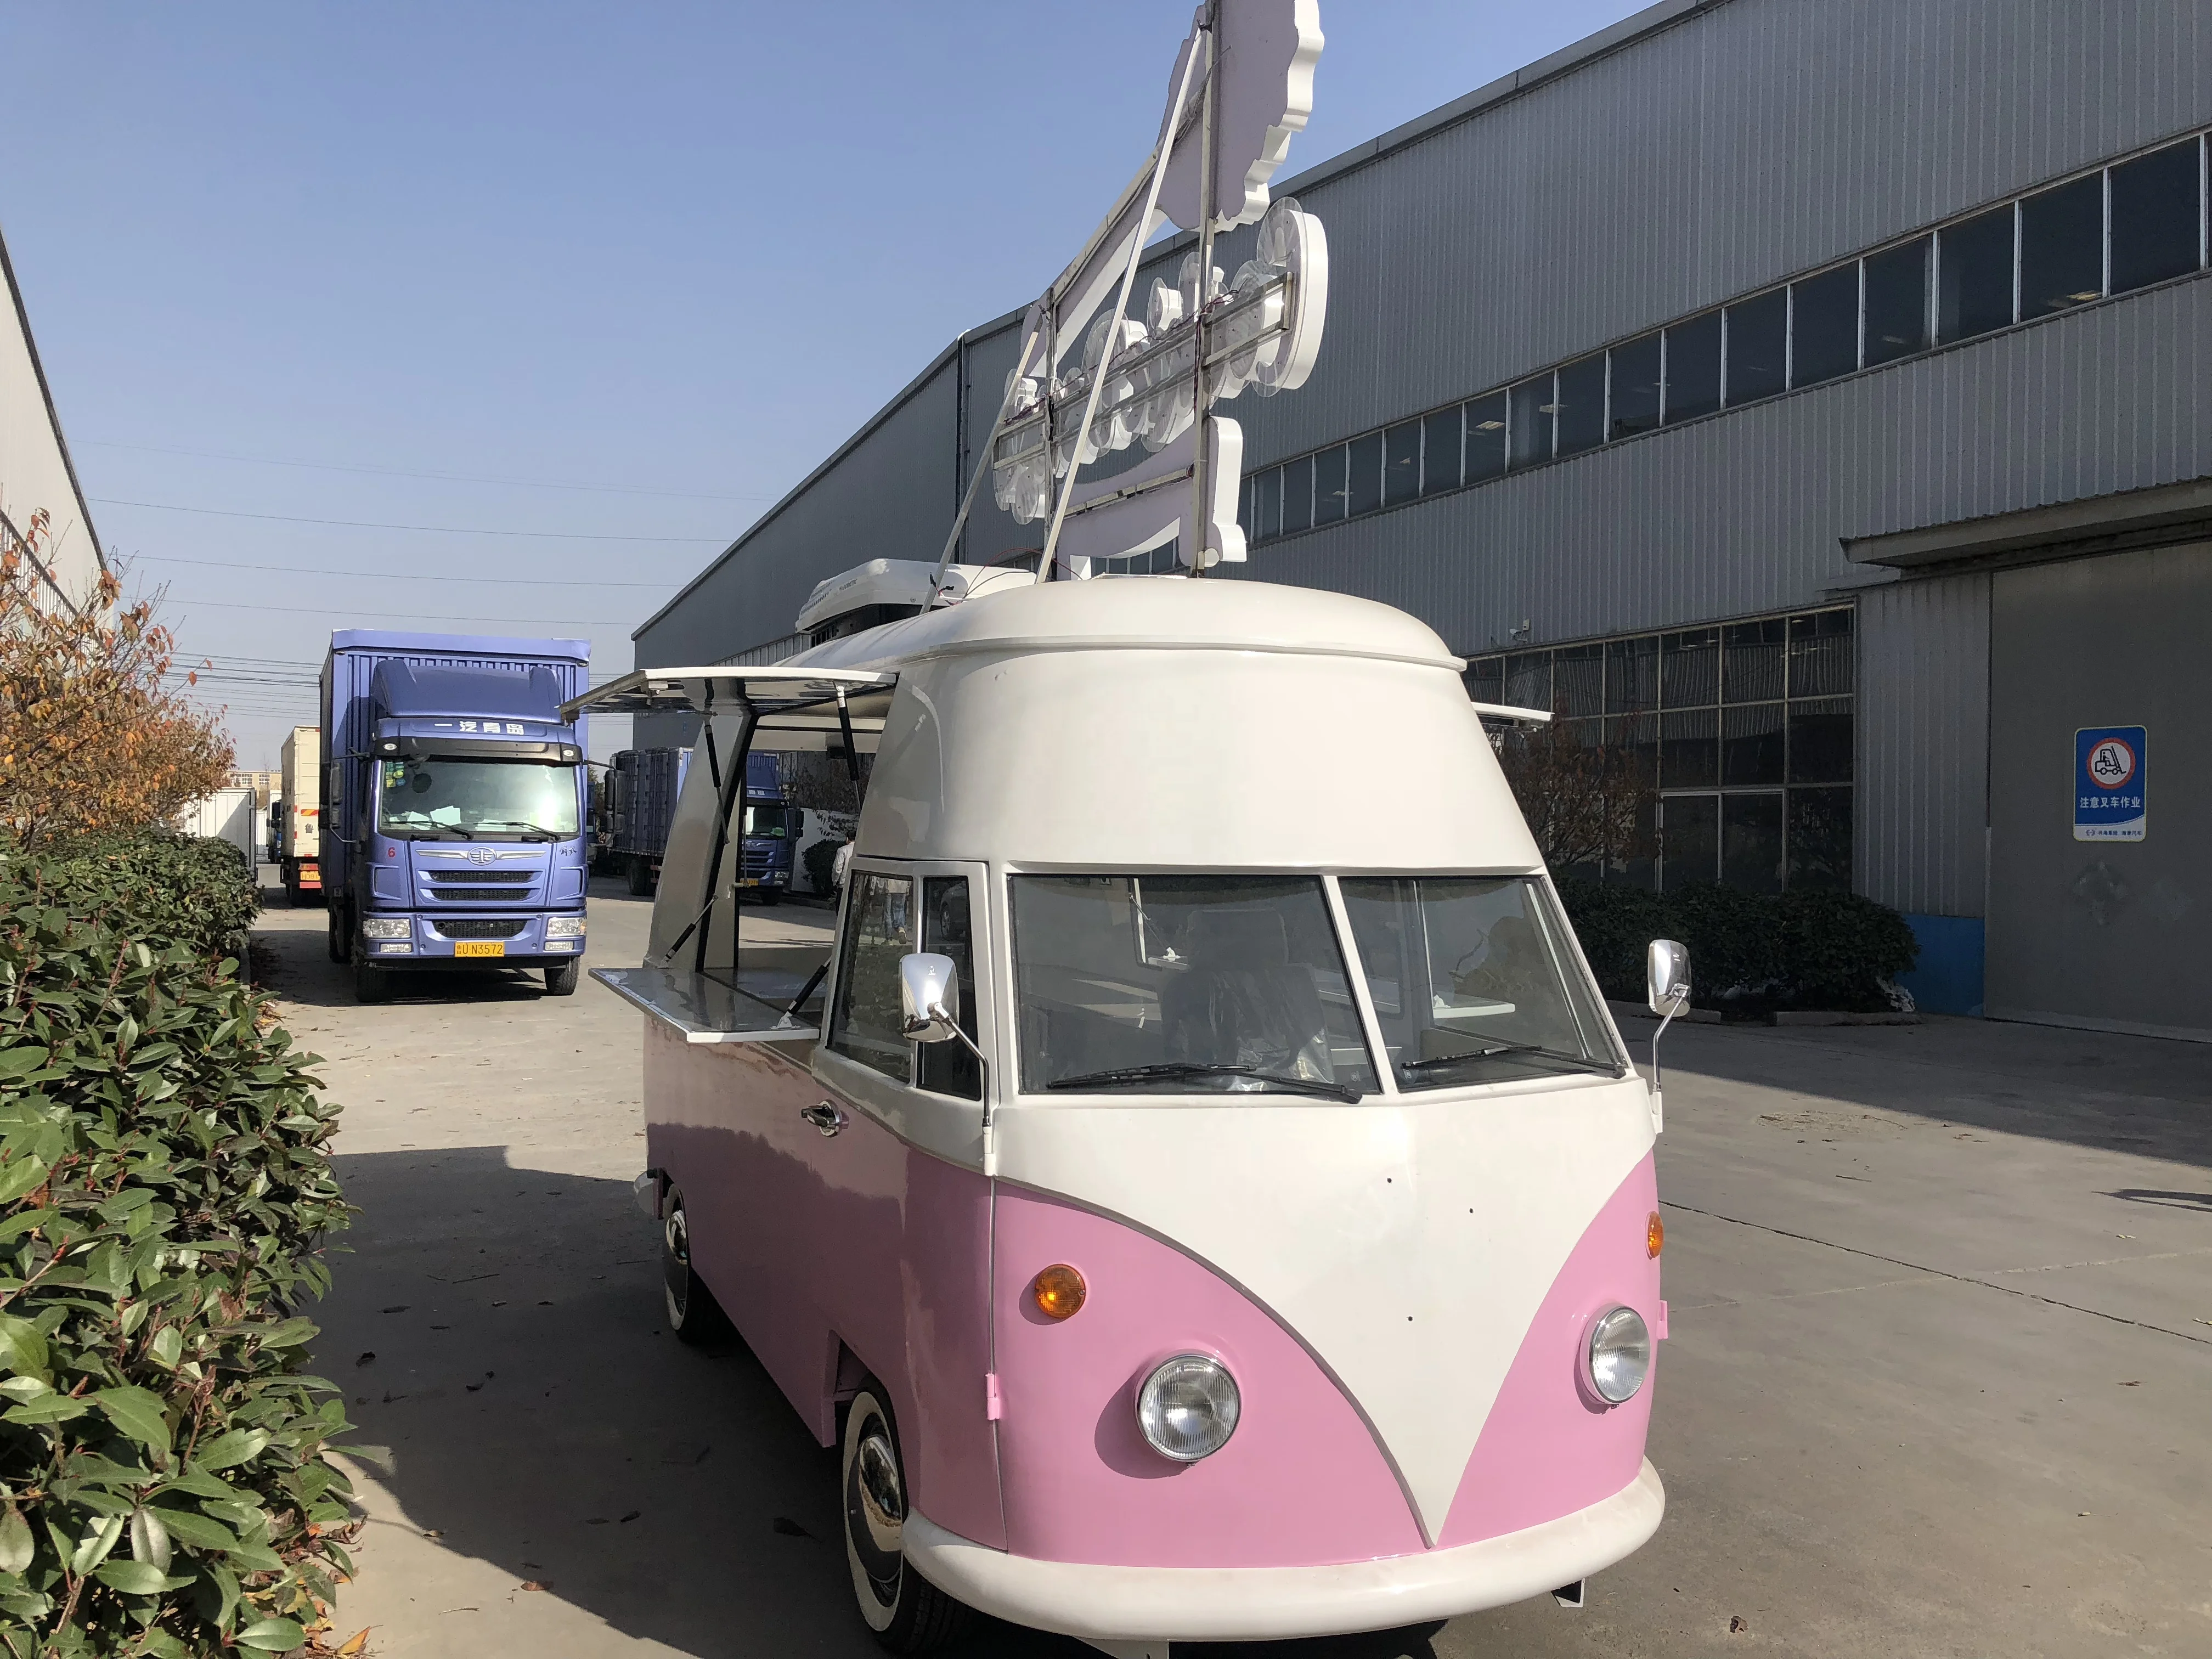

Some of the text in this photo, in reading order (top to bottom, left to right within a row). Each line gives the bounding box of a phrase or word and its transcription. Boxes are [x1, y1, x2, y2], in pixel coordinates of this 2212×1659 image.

[434, 720, 525, 736] 一汽青岛
[2080, 797, 2141, 808] 注意叉车作业
[388, 847, 396, 858] 6
